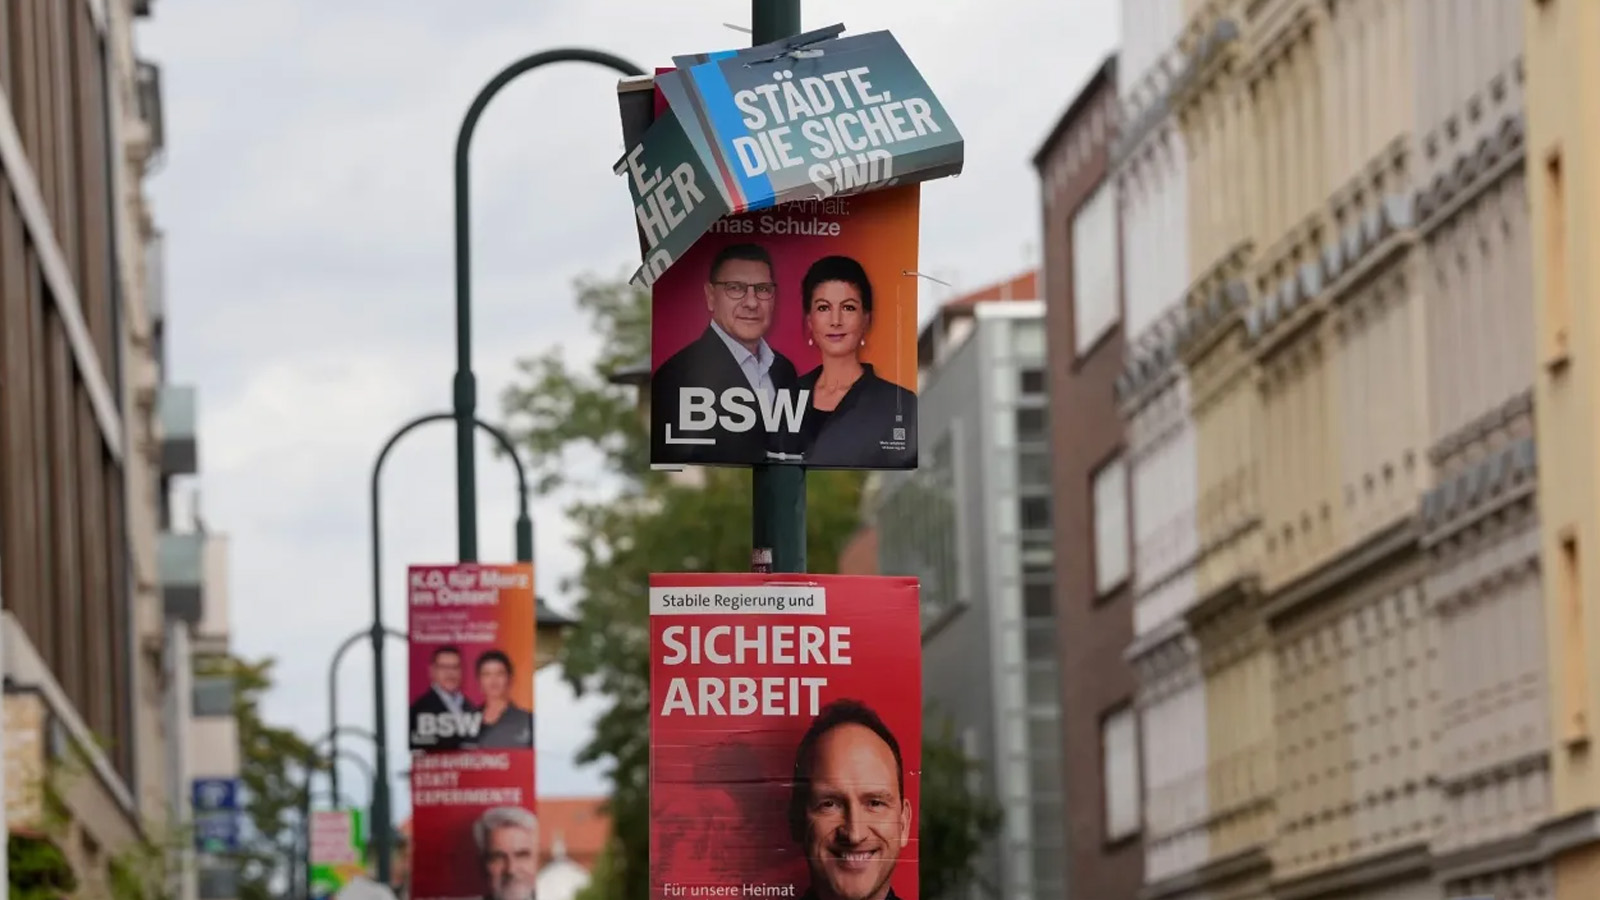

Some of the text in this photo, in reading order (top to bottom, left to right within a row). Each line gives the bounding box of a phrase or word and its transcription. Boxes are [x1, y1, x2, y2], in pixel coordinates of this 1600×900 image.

[734, 66, 891, 130] STÄDTE,
[732, 98, 942, 178] DIE SICHER
[759, 216, 841, 236] Schulze
[679, 386, 810, 433] BSW
[480, 570, 530, 589] Merz
[662, 594, 814, 610] Stabile Regierung und
[661, 625, 852, 666] SICHERE
[660, 677, 828, 717] ARBEIT
[417, 712, 483, 738] BSW
[663, 883, 795, 897] Für unsere Heimat
